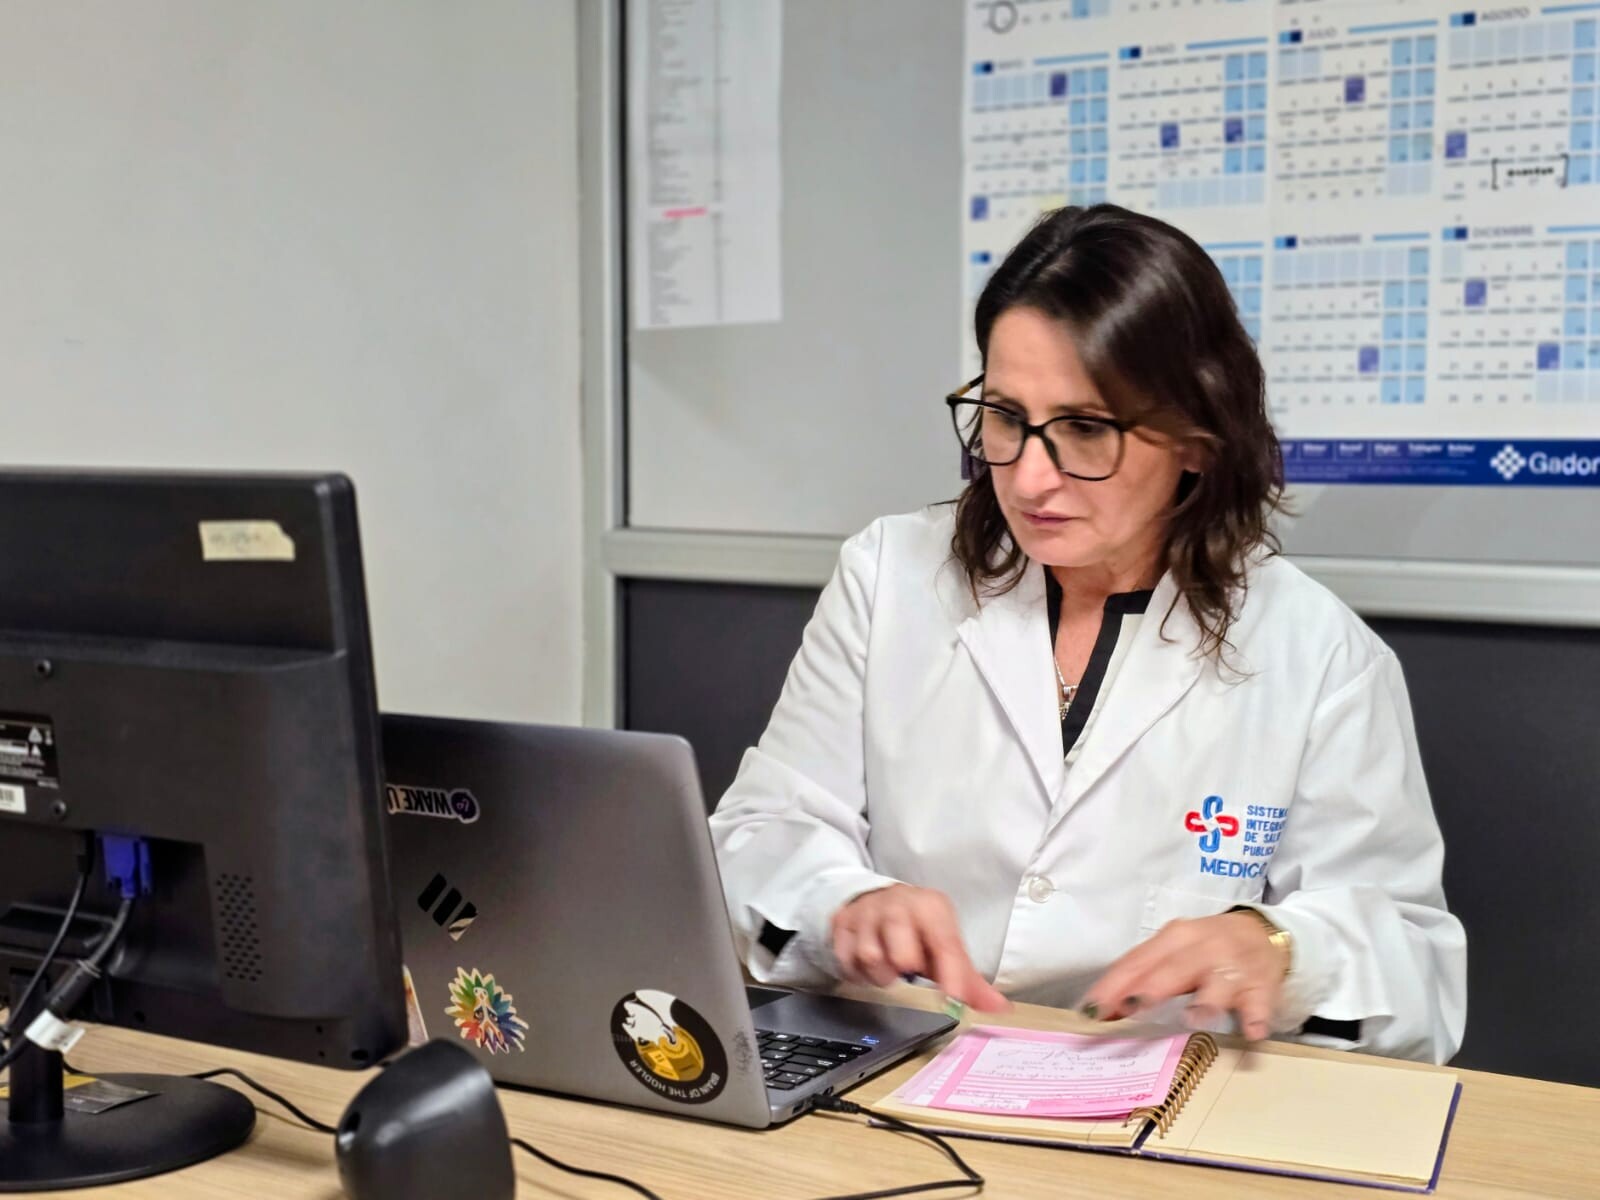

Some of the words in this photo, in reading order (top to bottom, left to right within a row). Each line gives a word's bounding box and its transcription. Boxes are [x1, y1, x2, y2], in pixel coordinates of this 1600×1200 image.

[1529, 451, 1600, 476] Gador
[400, 788, 453, 816] WAKE
[1245, 831, 1259, 843] DE
[629, 1059, 667, 1092] HODLER
[668, 1086, 688, 1098] THE
